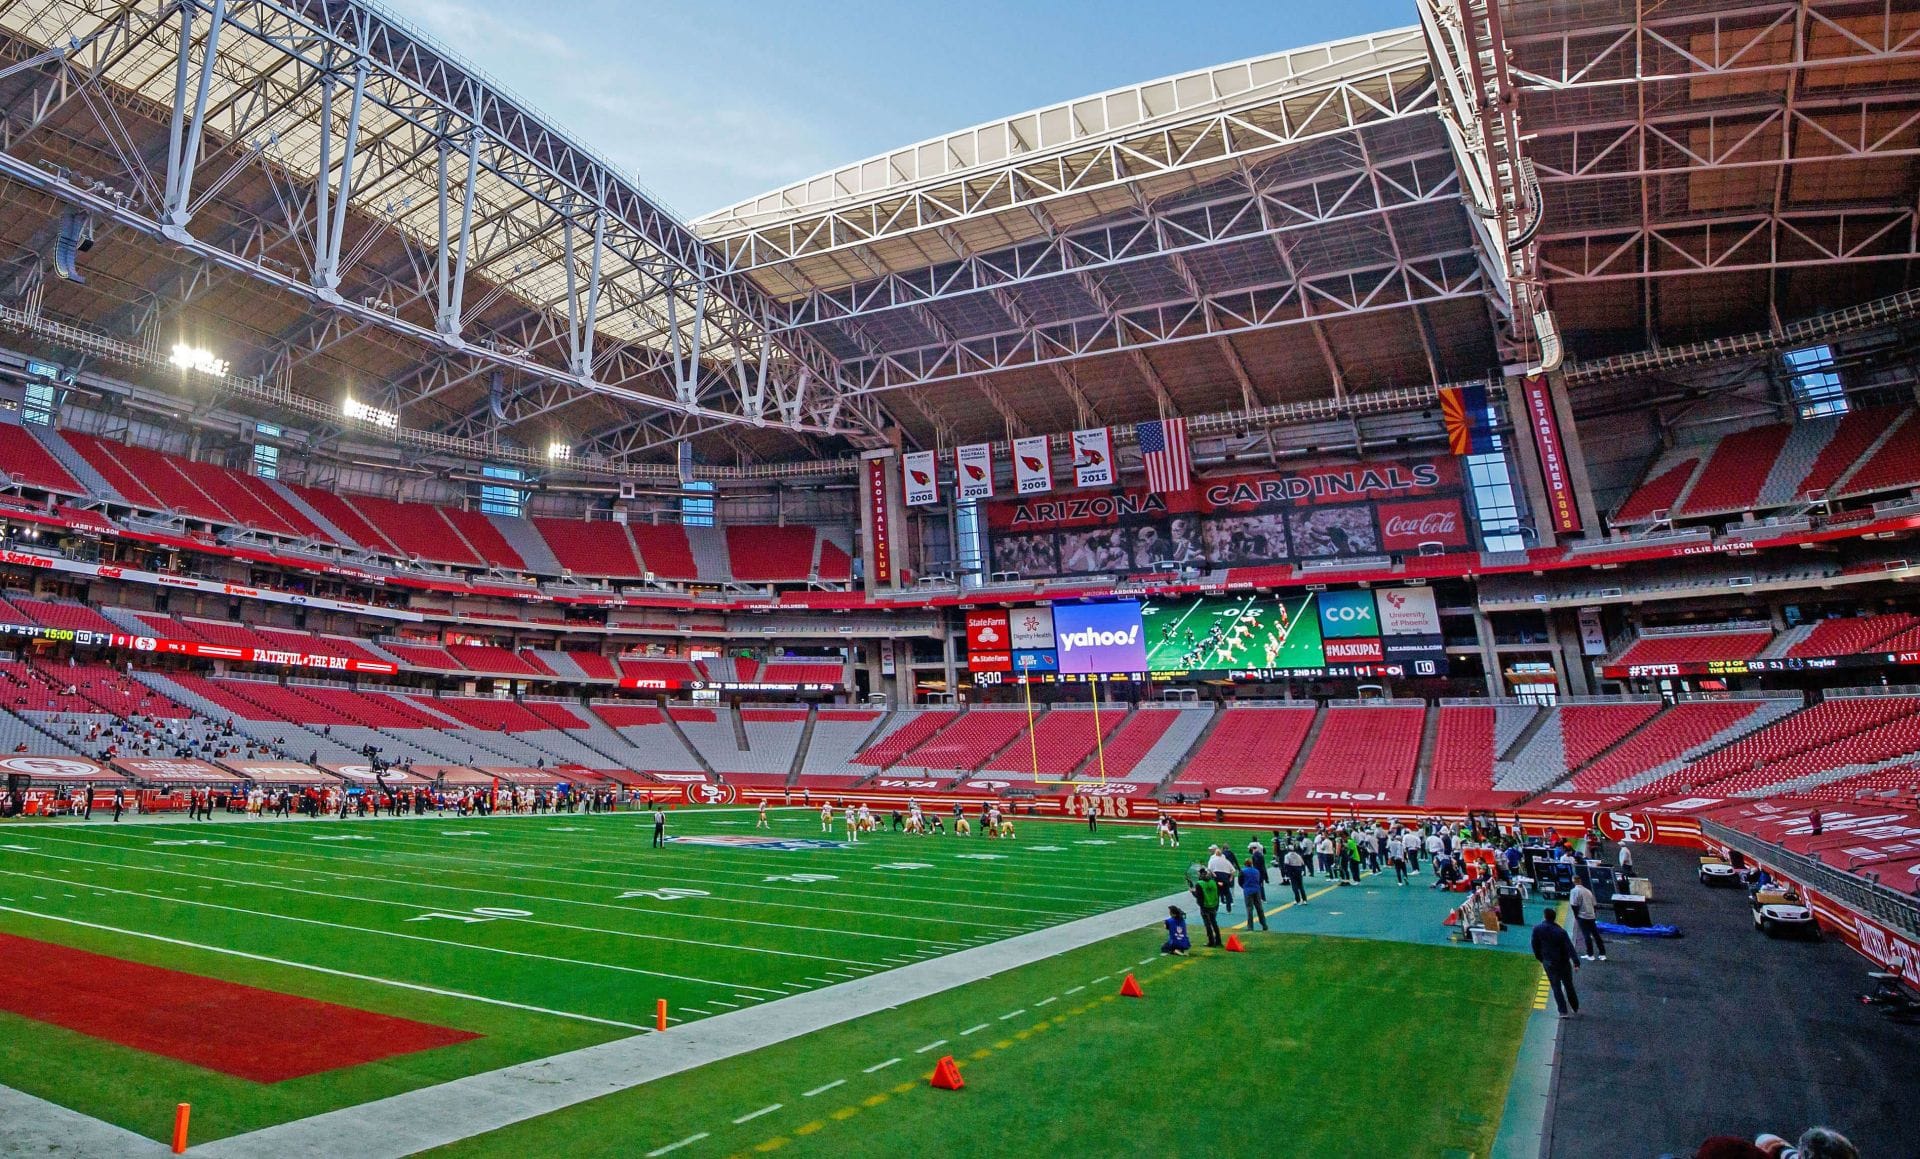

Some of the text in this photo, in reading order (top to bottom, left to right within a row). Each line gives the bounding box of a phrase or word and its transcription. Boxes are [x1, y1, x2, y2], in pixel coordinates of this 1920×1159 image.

[1532, 390, 1563, 490] ESTABLISHED
[1081, 473, 1108, 483] 2015
[964, 488, 989, 496] 2008
[1022, 482, 1047, 491] 2009
[910, 494, 934, 503] 2008
[1011, 465, 1440, 525] ARIZONA CARDINALS
[874, 471, 885, 541] FOOTBALL
[1556, 491, 1572, 529] 1898
[71, 522, 94, 531] LARRY
[94, 526, 120, 536] WILSON
[1684, 545, 1711, 555] OLLIE
[1713, 542, 1754, 552] MATSON
[878, 543, 886, 578] CLUB
[1389, 610, 1425, 619] University
[1400, 619, 1429, 627] Phoenix
[27, 628, 39, 636] 31
[44, 629, 74, 641] 15:00
[1060, 625, 1139, 652] yahoo!
[1326, 643, 1382, 657] #MASKUPAZ
[253, 649, 303, 665] FAITHFUL
[308, 654, 327, 667] THE
[329, 657, 349, 669] BAY
[1749, 661, 1765, 670] RB
[1807, 659, 1837, 668] Taylor
[1628, 663, 1680, 677] #FTTB
[974, 671, 1002, 684] 15:00
